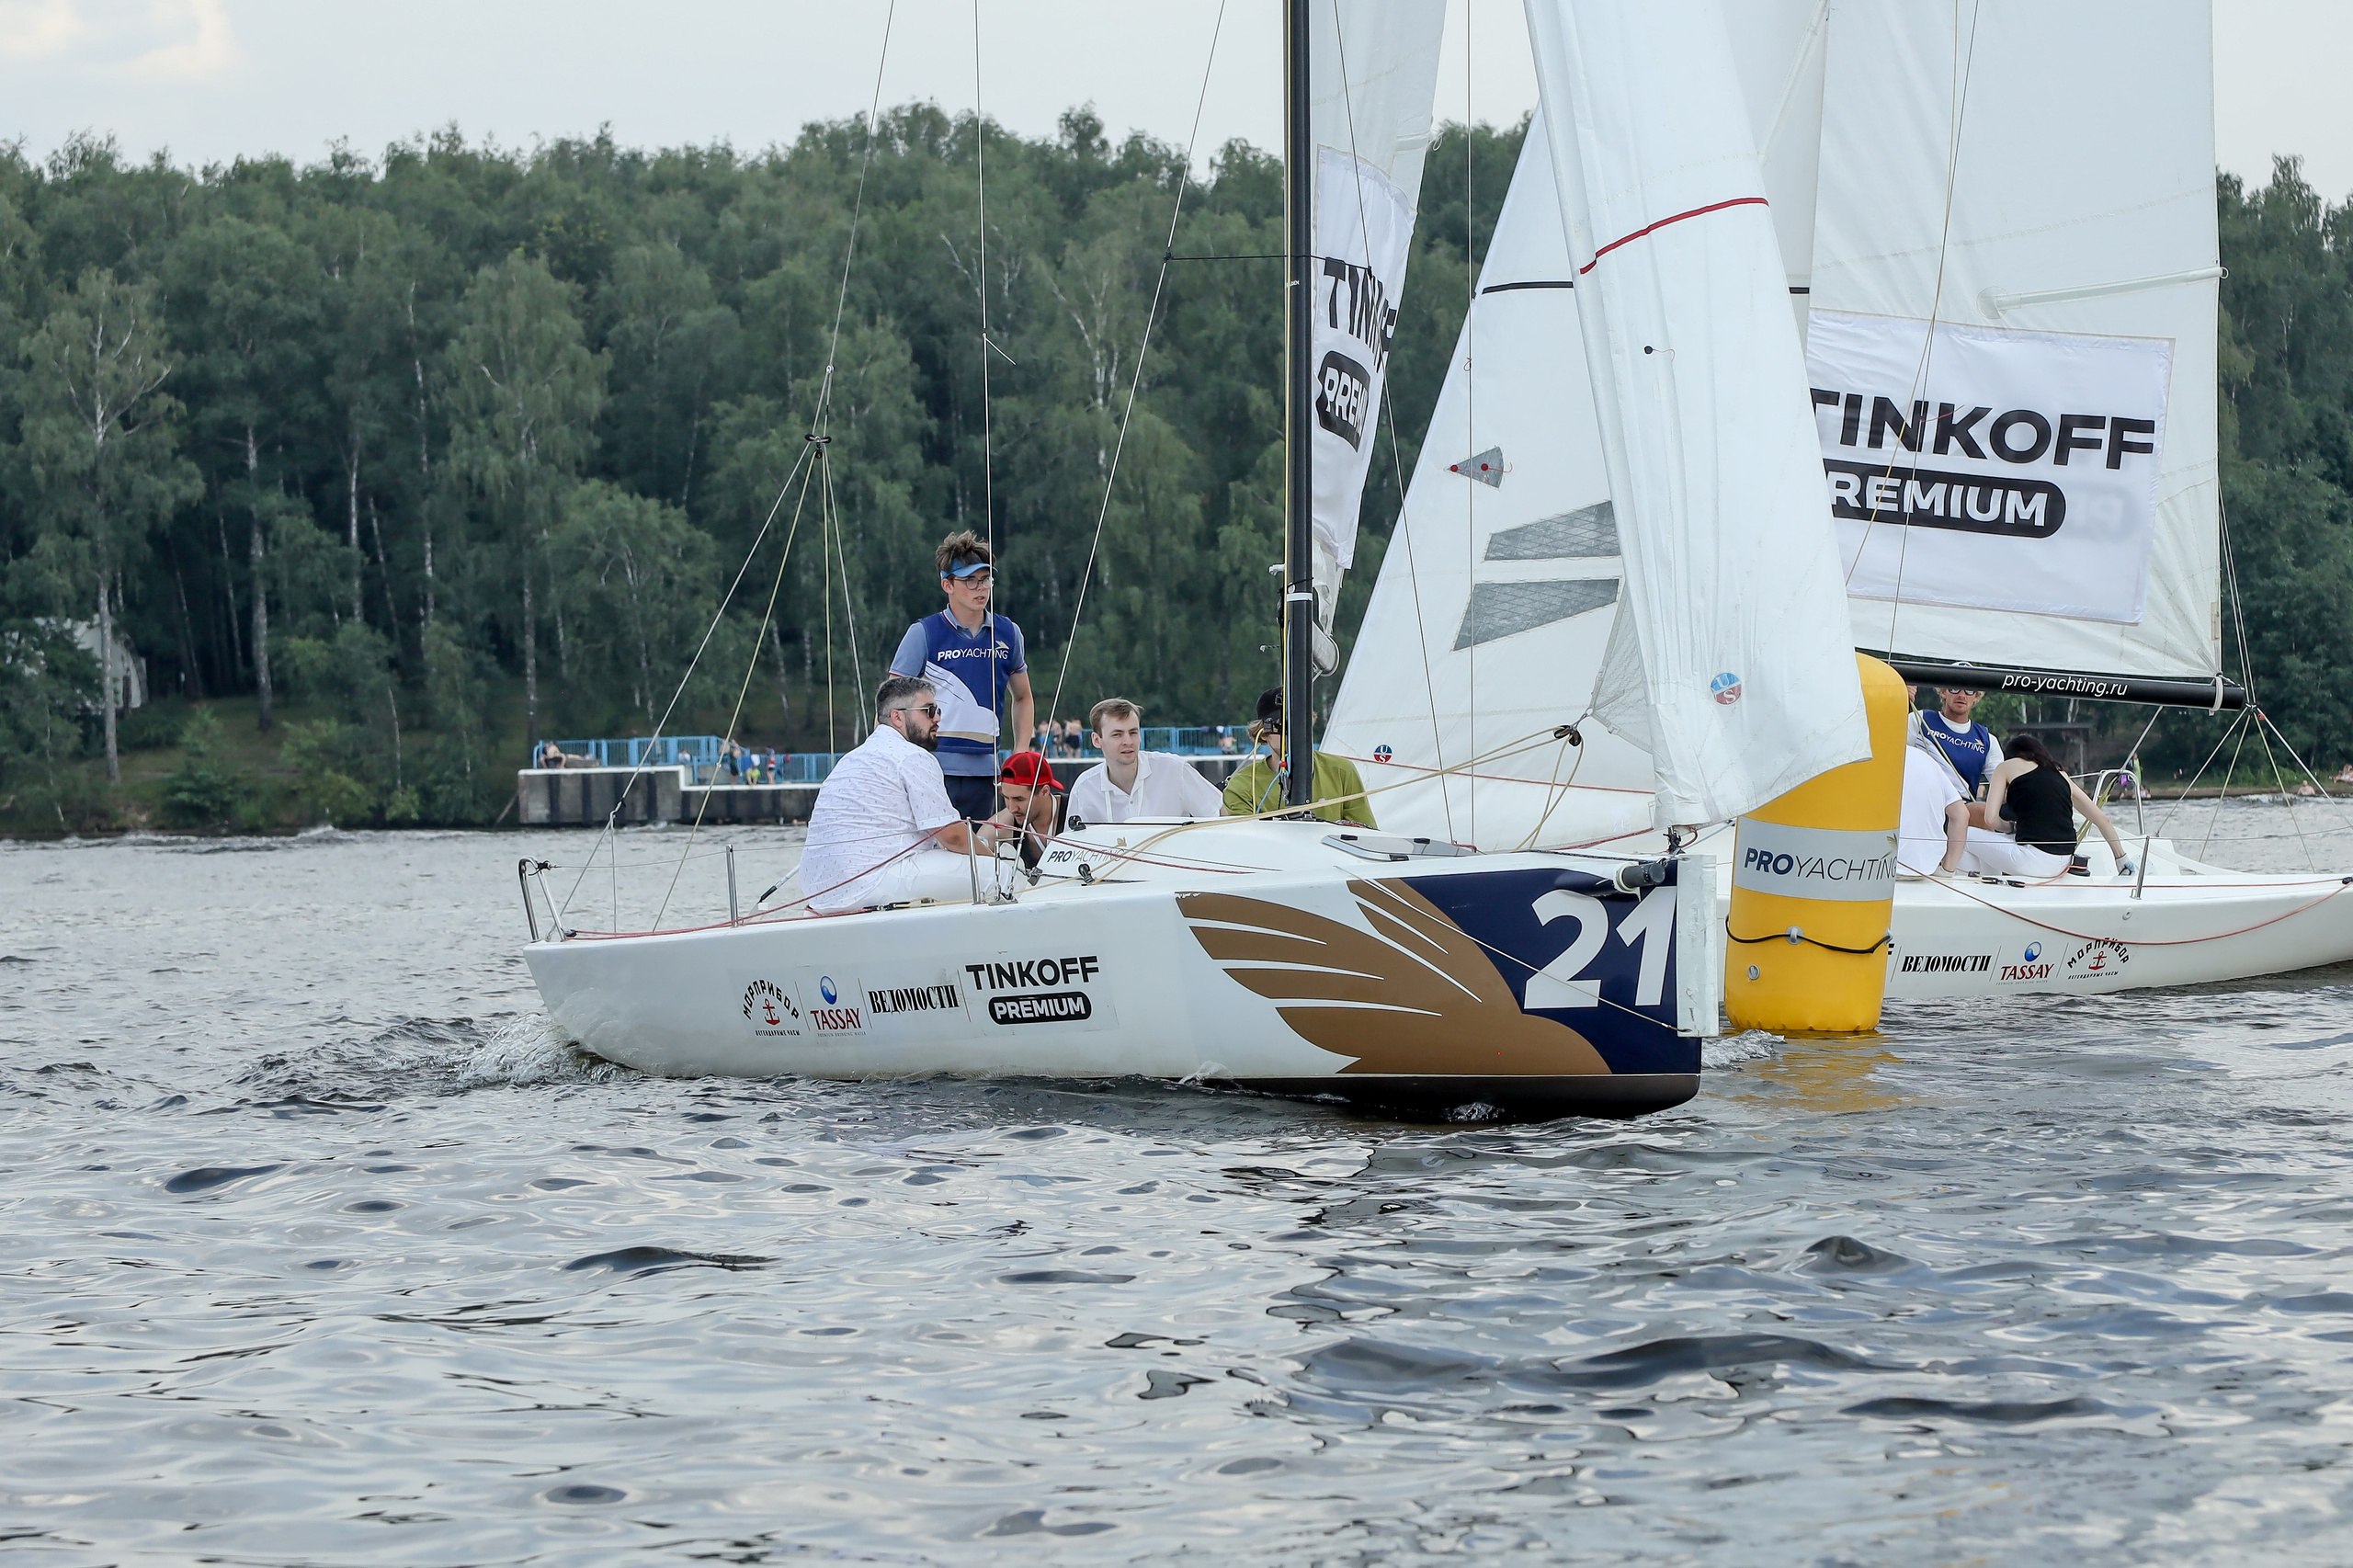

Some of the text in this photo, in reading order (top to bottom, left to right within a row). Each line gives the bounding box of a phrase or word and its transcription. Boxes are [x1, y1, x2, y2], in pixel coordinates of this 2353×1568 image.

[1826, 471, 2049, 527] REMIUM
[938, 647, 1009, 662] PROYACHTNG
[2001, 672, 2129, 698] pro-yachting.ru
[1744, 846, 1898, 881] PROYACHTING
[1523, 885, 1678, 1010] 21
[965, 955, 1100, 990] TINKOFF
[1901, 954, 1993, 974] ВЕДОМОСТИ
[2000, 963, 2055, 981] TASSAY
[743, 979, 800, 1020] МОРПРИБОР
[868, 984, 961, 1015] ВЕДОМОСТИ
[994, 995, 1087, 1019] PREMIUM
[810, 1007, 863, 1030] TASSAY
